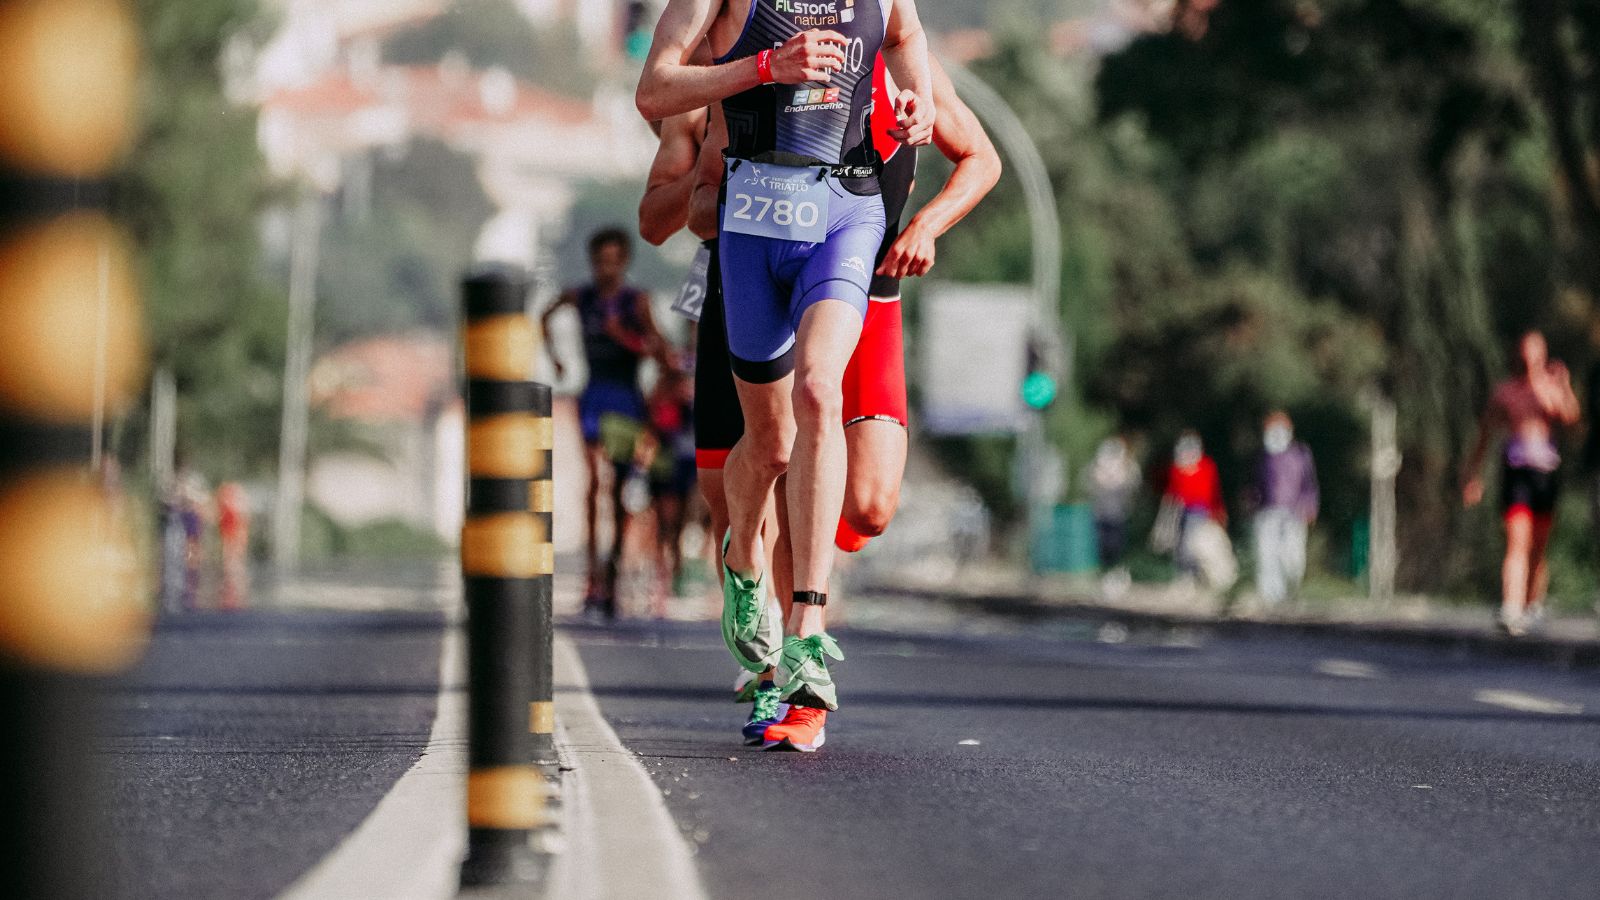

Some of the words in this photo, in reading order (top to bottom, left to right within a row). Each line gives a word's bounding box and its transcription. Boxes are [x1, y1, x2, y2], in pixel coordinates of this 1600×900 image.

[794, 13, 838, 26] natural
[784, 102, 844, 113] EnduranceTrio
[733, 193, 819, 228] 2780
